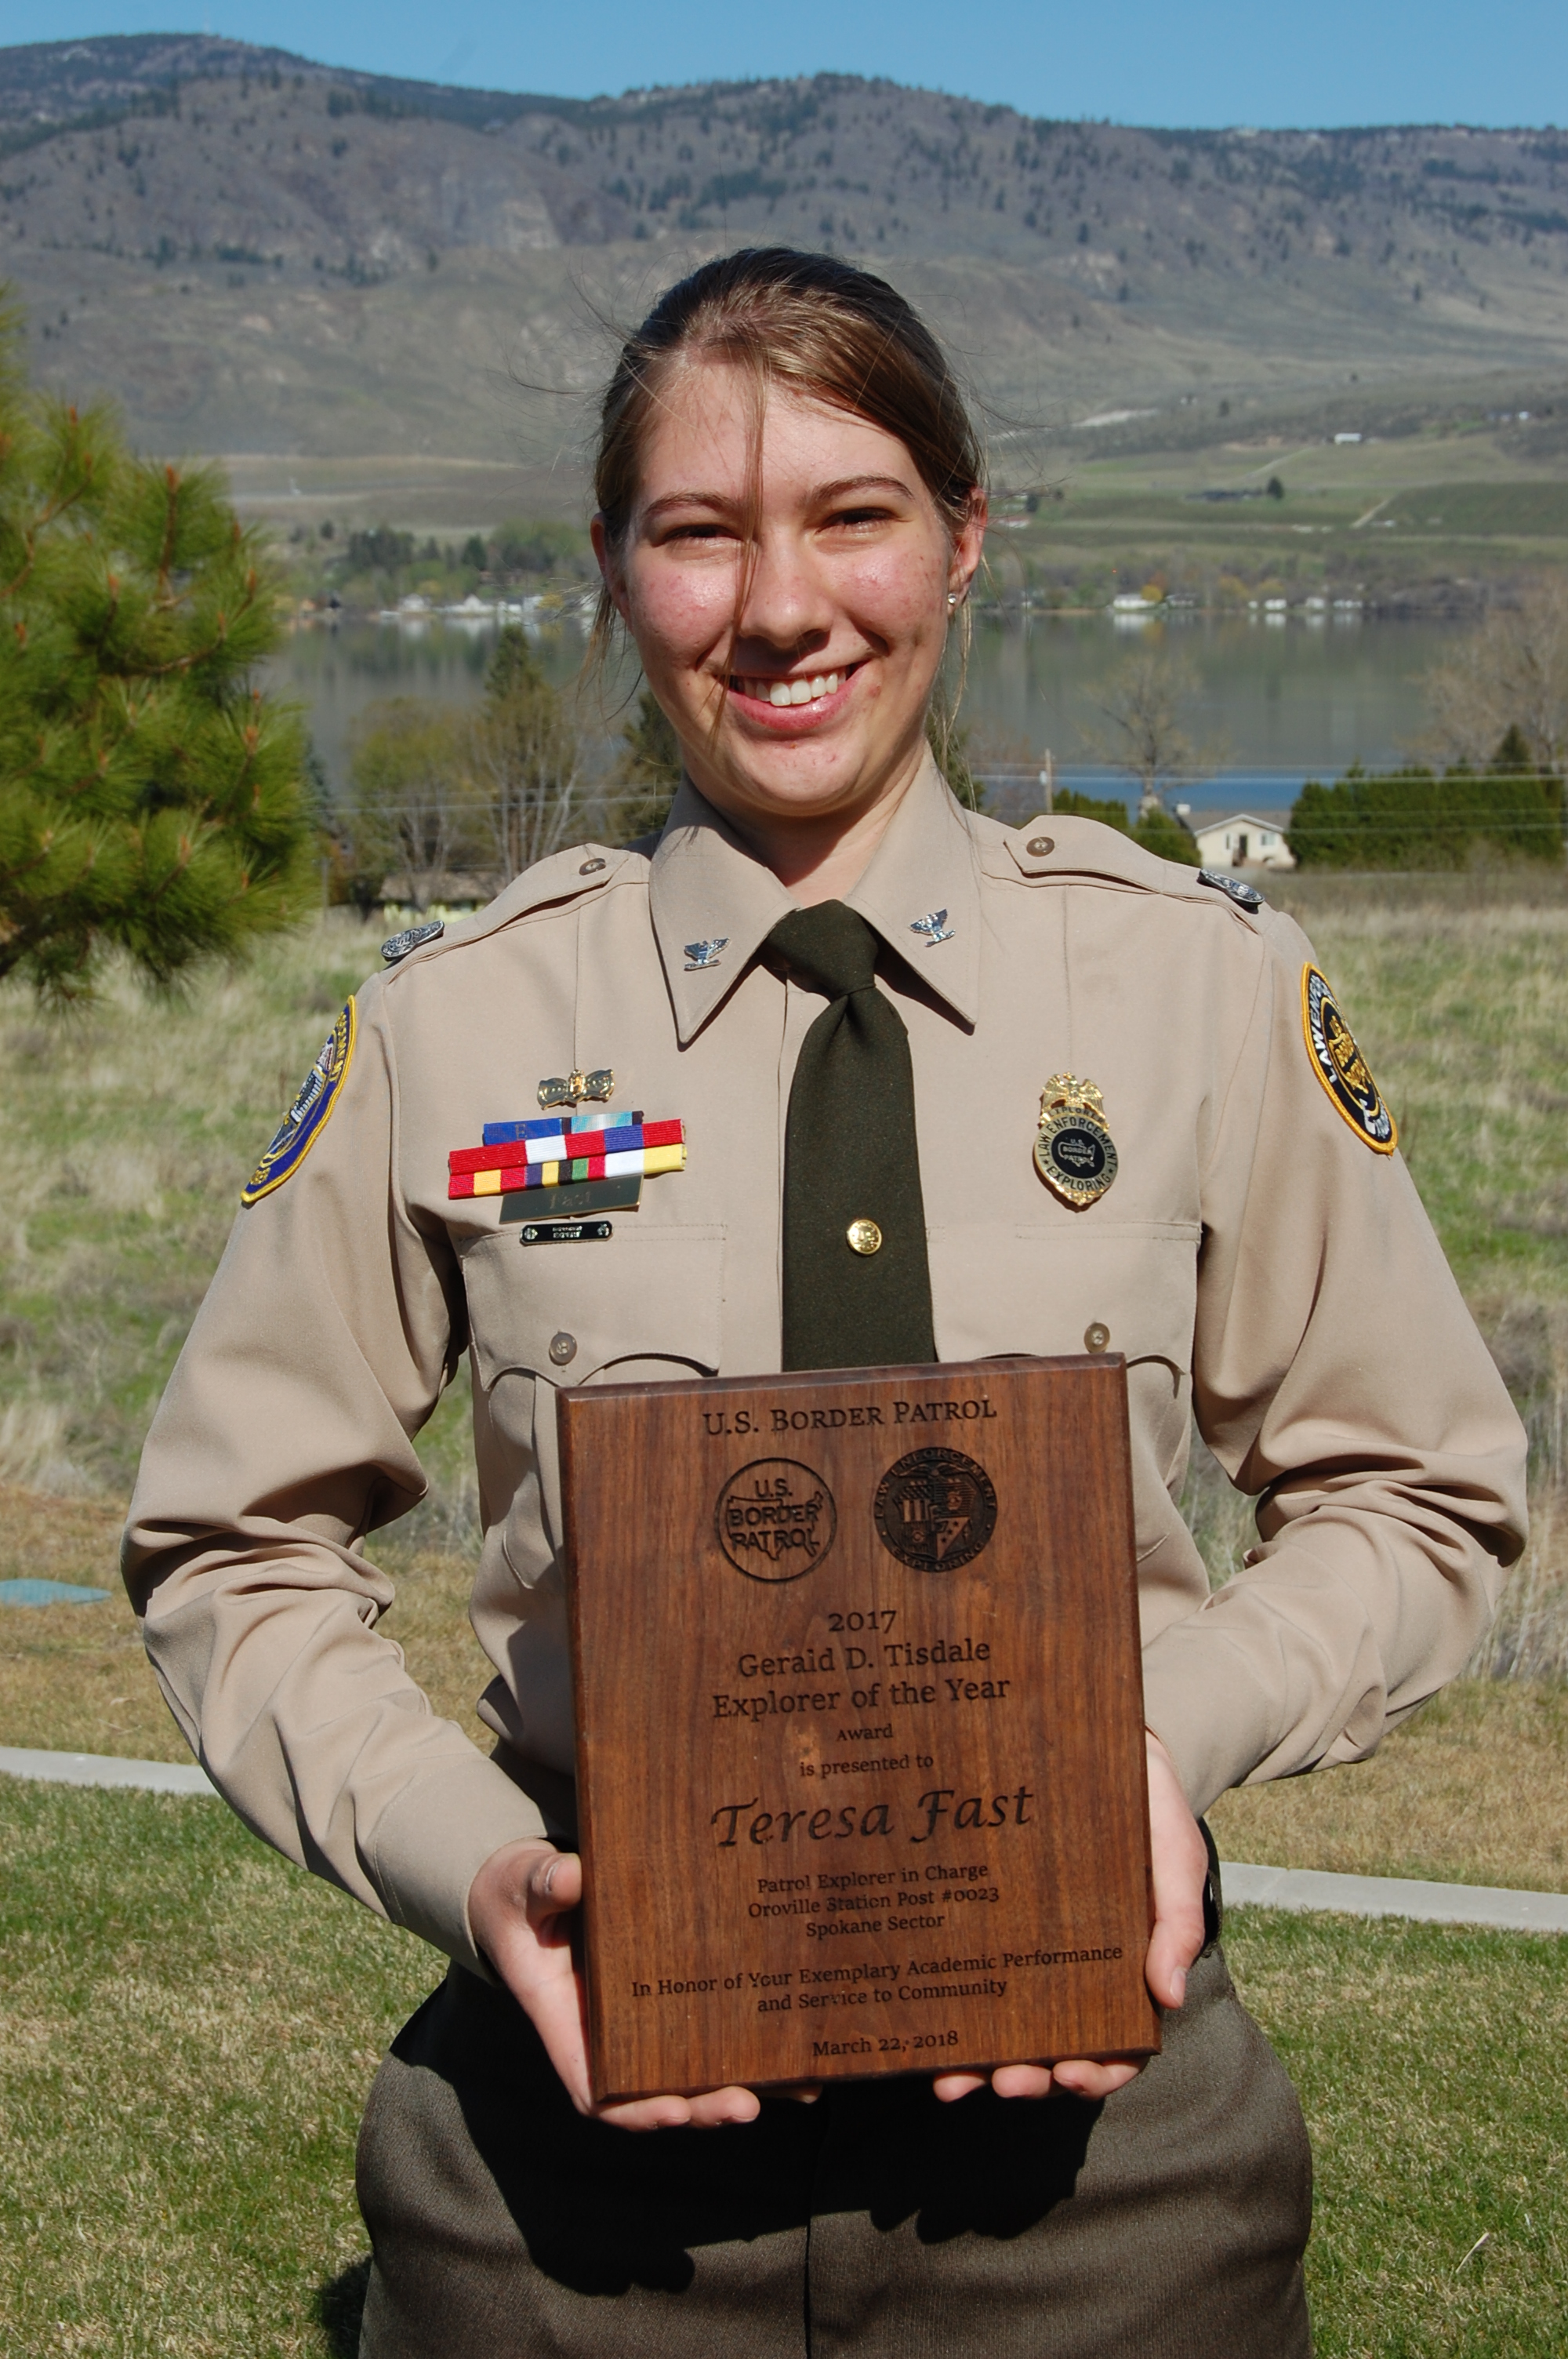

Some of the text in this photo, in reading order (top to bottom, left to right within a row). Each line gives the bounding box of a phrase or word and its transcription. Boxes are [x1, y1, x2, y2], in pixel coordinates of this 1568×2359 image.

[1038, 1116, 1117, 1166] LAW ENFORCEMENT
[1046, 1165, 1112, 1191] EXPLORING
[702, 1412, 759, 1436] U.S.
[754, 1478, 793, 1498] U.S.
[875, 1448, 996, 1519] LAW ENFORCEMENT
[728, 1503, 819, 1528] BORDER
[731, 1527, 820, 1552] PATROL
[891, 1542, 985, 1572] EXPLORING
[828, 1609, 898, 1634] 2017
[738, 1638, 992, 1677] Gerald D. Tisdale
[713, 1677, 1011, 1722] Explorer of the Year
[837, 1724, 894, 1742] Award
[800, 1754, 934, 1779] is presented to
[710, 1786, 1033, 1848] Teresa Fast
[757, 1864, 989, 1894] Patrol Explorer in Charge
[748, 1887, 1000, 1918] Oroville Station Post #0023
[806, 1914, 946, 1941] Spokane Sector
[632, 1946, 1123, 1997] In Honor of Your Exemplary Academic Performance
[757, 1978, 1007, 2012] and Service to Community
[812, 2030, 959, 2057] March 22, 2018
